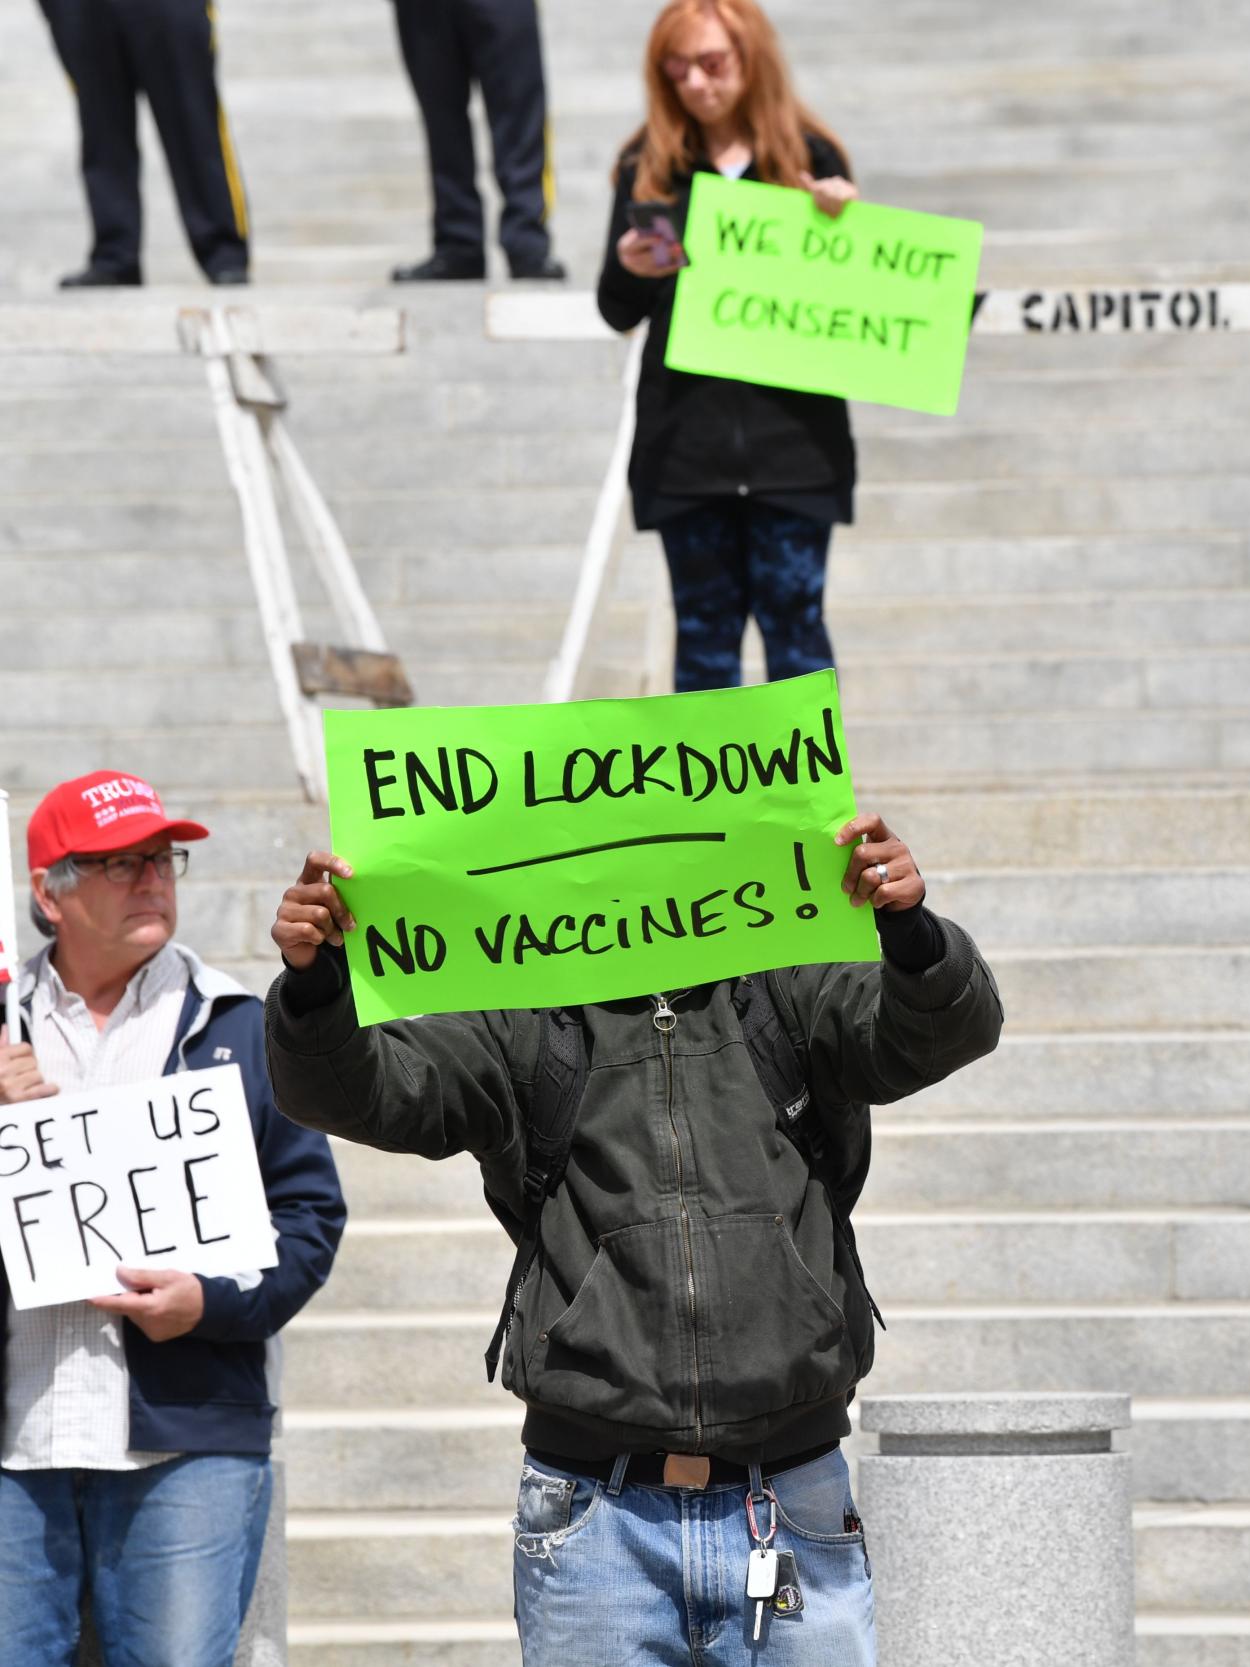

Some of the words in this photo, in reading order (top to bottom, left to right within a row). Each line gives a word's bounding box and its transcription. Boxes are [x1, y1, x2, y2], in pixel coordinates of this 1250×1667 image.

[715, 211, 783, 256] WE
[803, 226, 852, 265] DO
[871, 240, 957, 280] NOT
[712, 289, 931, 354] CONSENT
[1021, 290, 1230, 332] CAPITOL
[364, 746, 499, 819] END
[524, 708, 844, 807] LOCKDOWN
[365, 917, 447, 977] NO
[0, 1110, 98, 1177] SET
[13, 1153, 231, 1283] FREE
